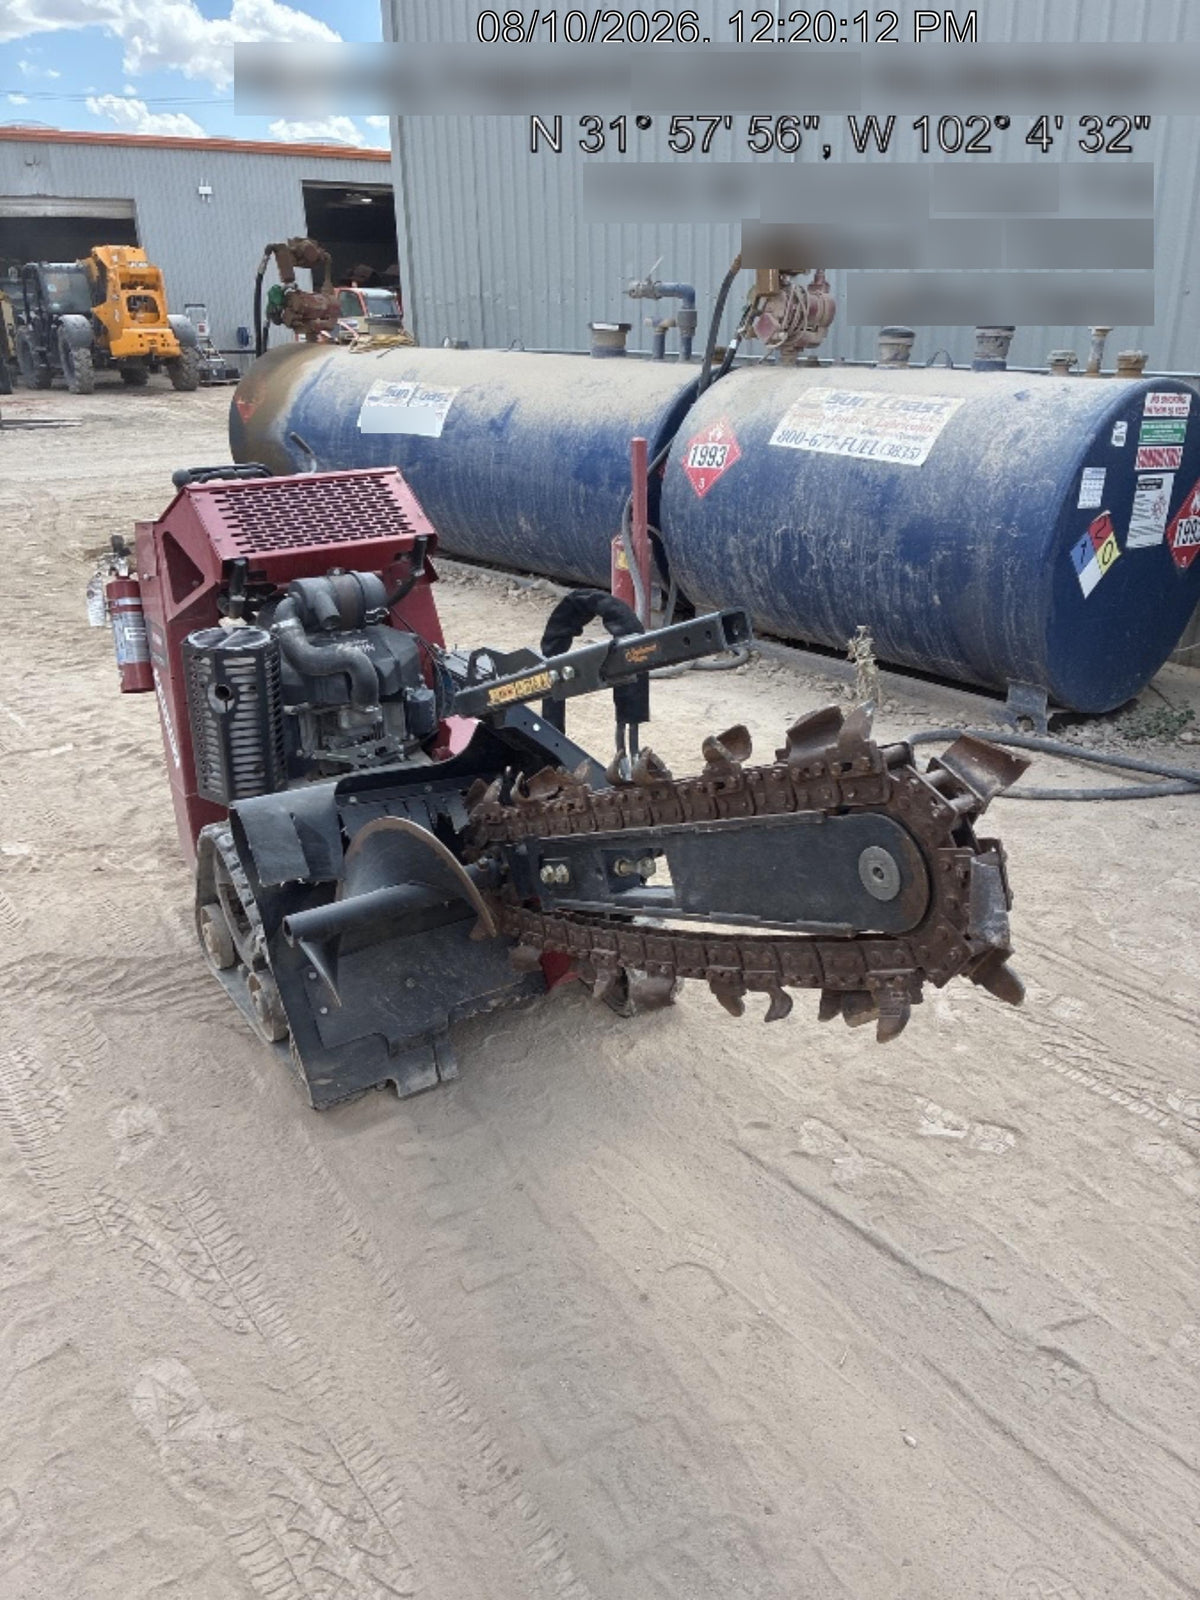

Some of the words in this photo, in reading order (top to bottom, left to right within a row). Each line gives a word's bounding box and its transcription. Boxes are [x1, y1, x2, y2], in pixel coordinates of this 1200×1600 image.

[825, 391, 865, 407] Sun
[875, 396, 947, 414] Coast
[690, 445, 728, 467] 1993
[699, 477, 705, 490] 3
[1095, 515, 1107, 540] 2
[1102, 540, 1114, 566] 0
